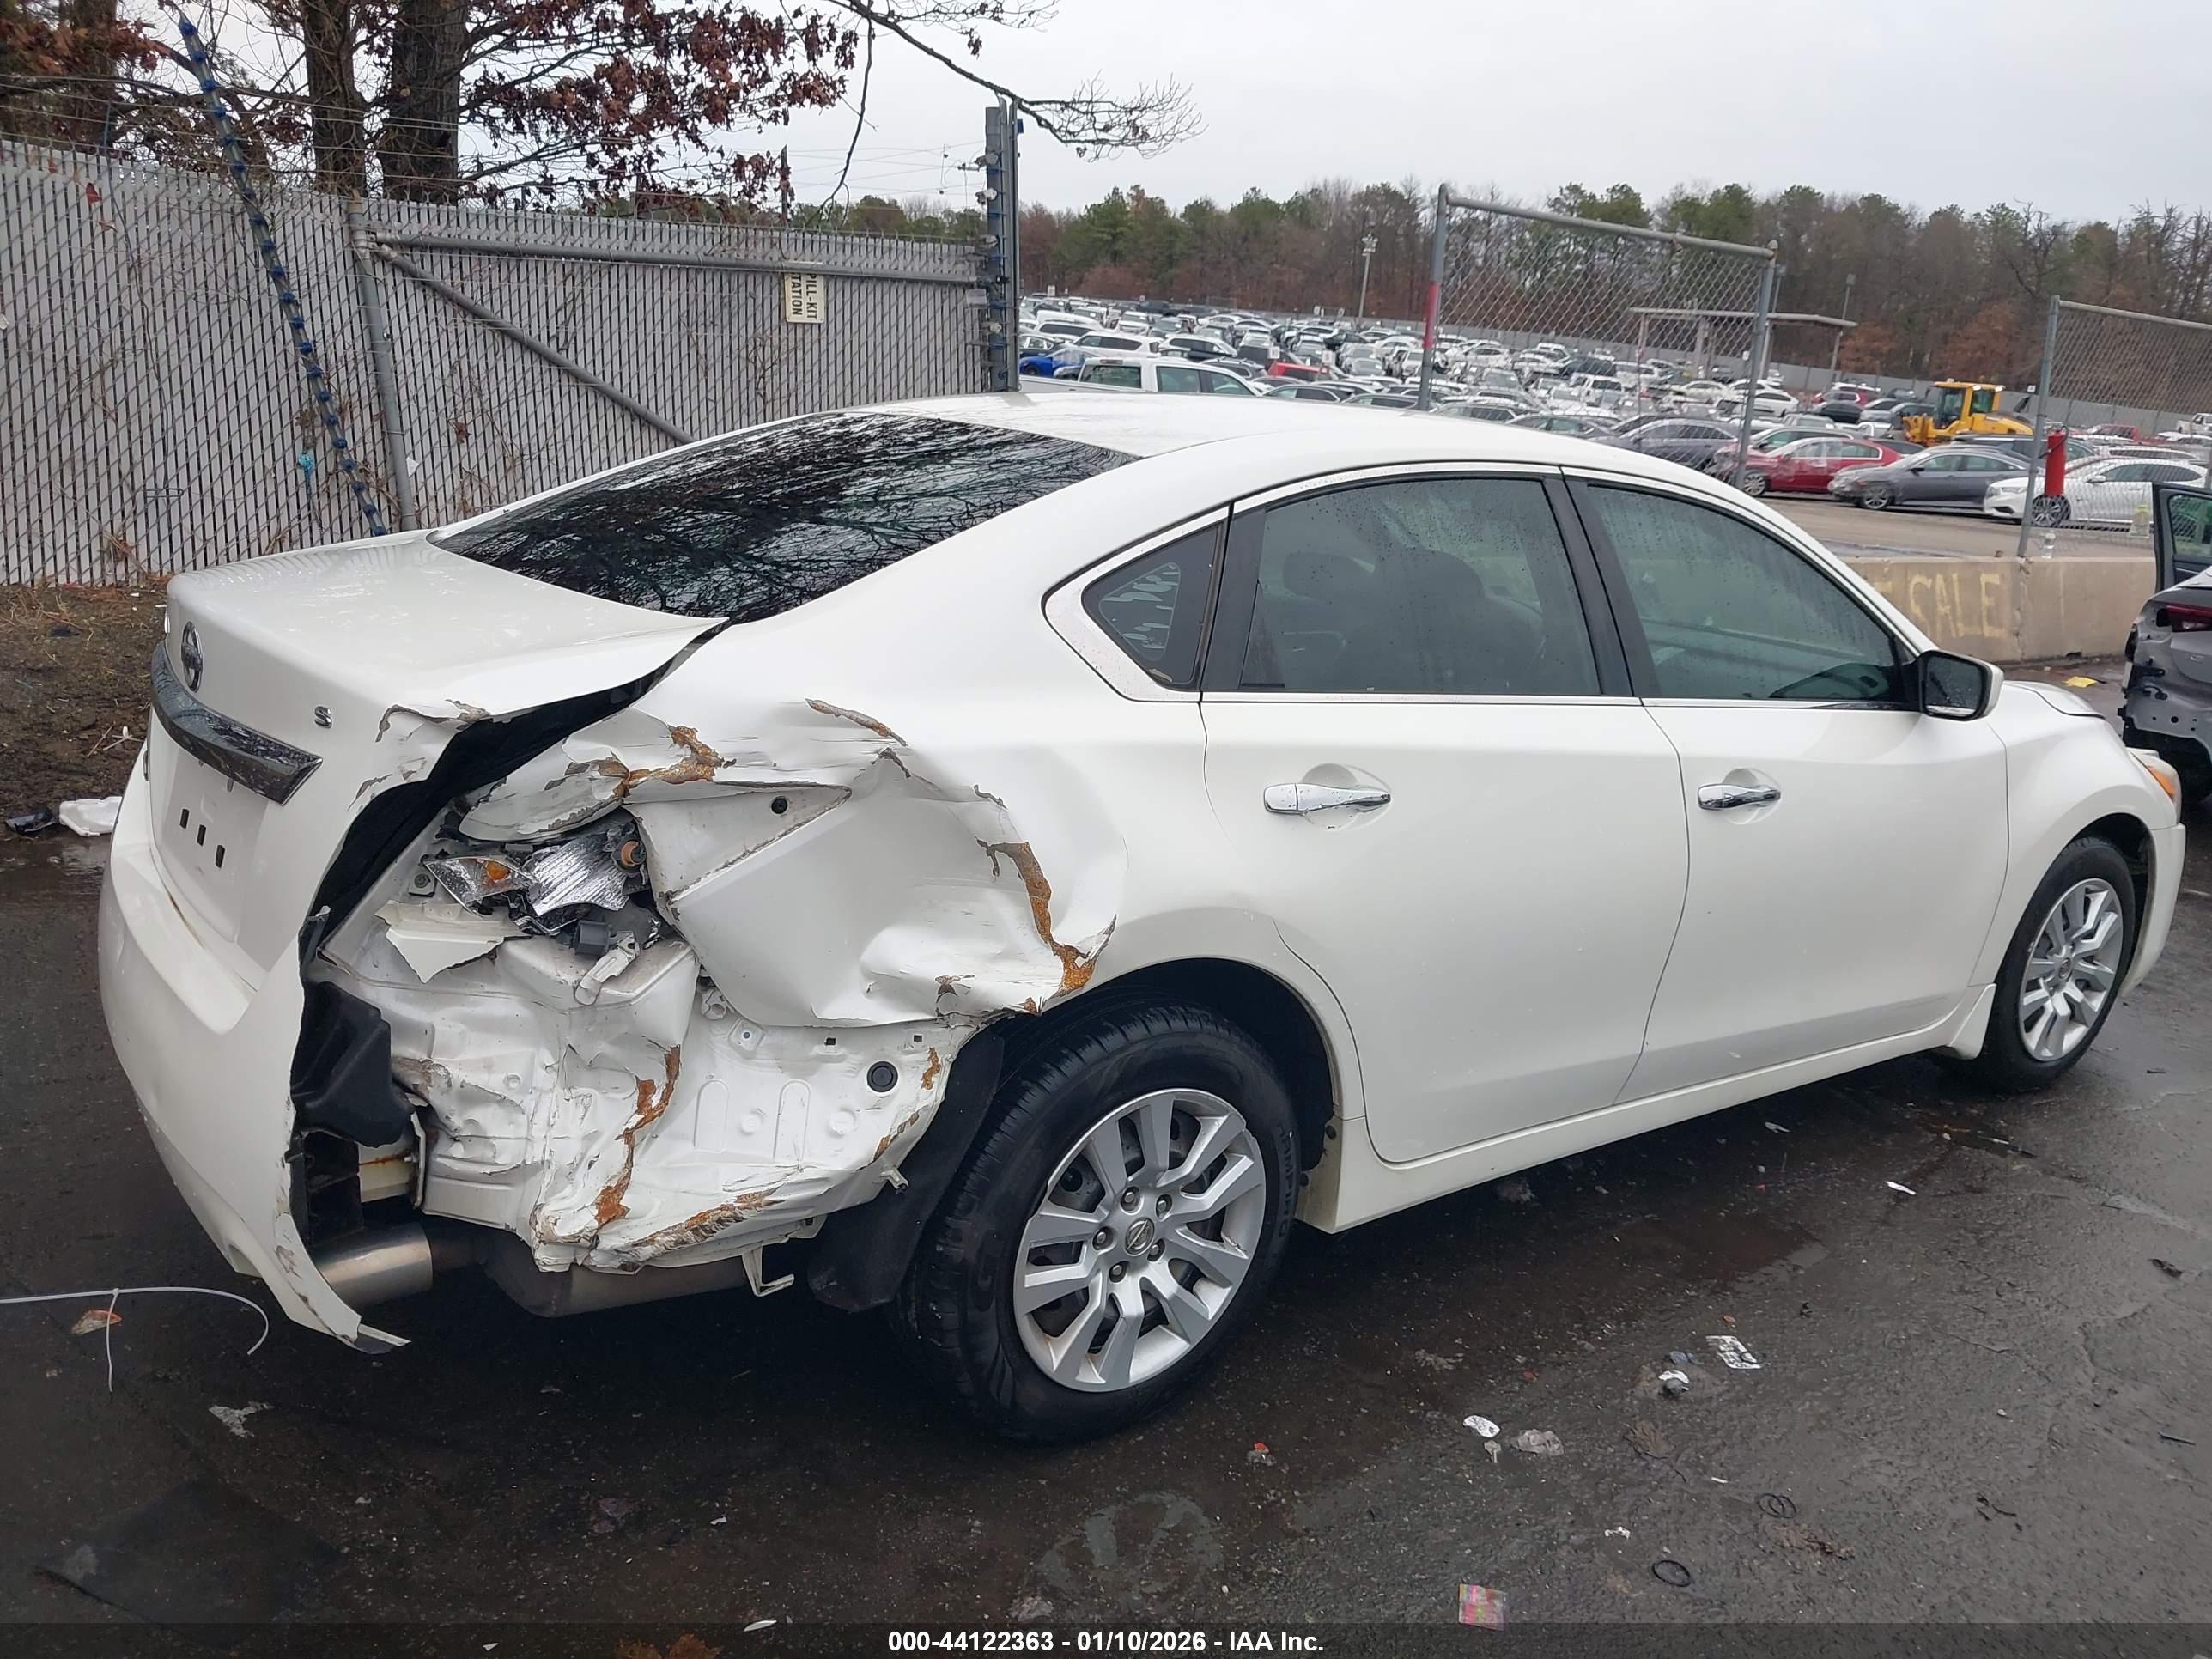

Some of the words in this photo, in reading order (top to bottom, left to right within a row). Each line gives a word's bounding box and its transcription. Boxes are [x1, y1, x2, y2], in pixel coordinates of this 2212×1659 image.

[791, 272, 803, 315] TATION
[806, 273, 817, 319] PILL-KIT
[314, 706, 332, 729] S
